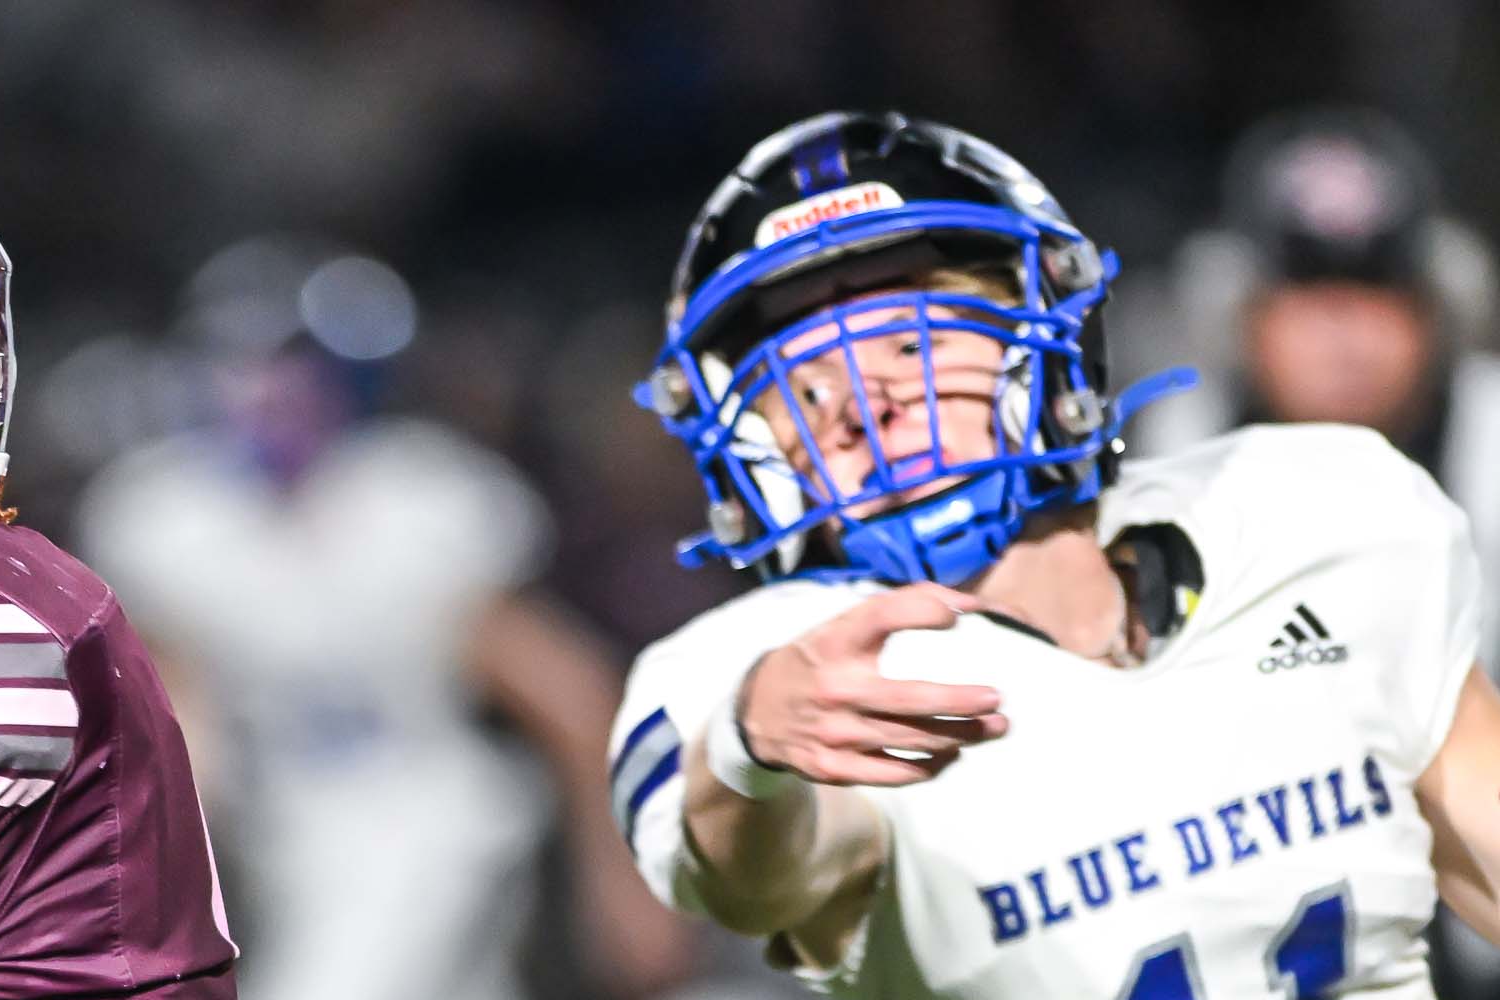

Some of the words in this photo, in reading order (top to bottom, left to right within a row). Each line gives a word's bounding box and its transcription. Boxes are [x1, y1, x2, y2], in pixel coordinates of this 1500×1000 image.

[772, 190, 881, 238] Riddell
[1257, 644, 1349, 674] adidas
[978, 831, 1160, 948] BLUE
[1173, 754, 1393, 878] DEVILS
